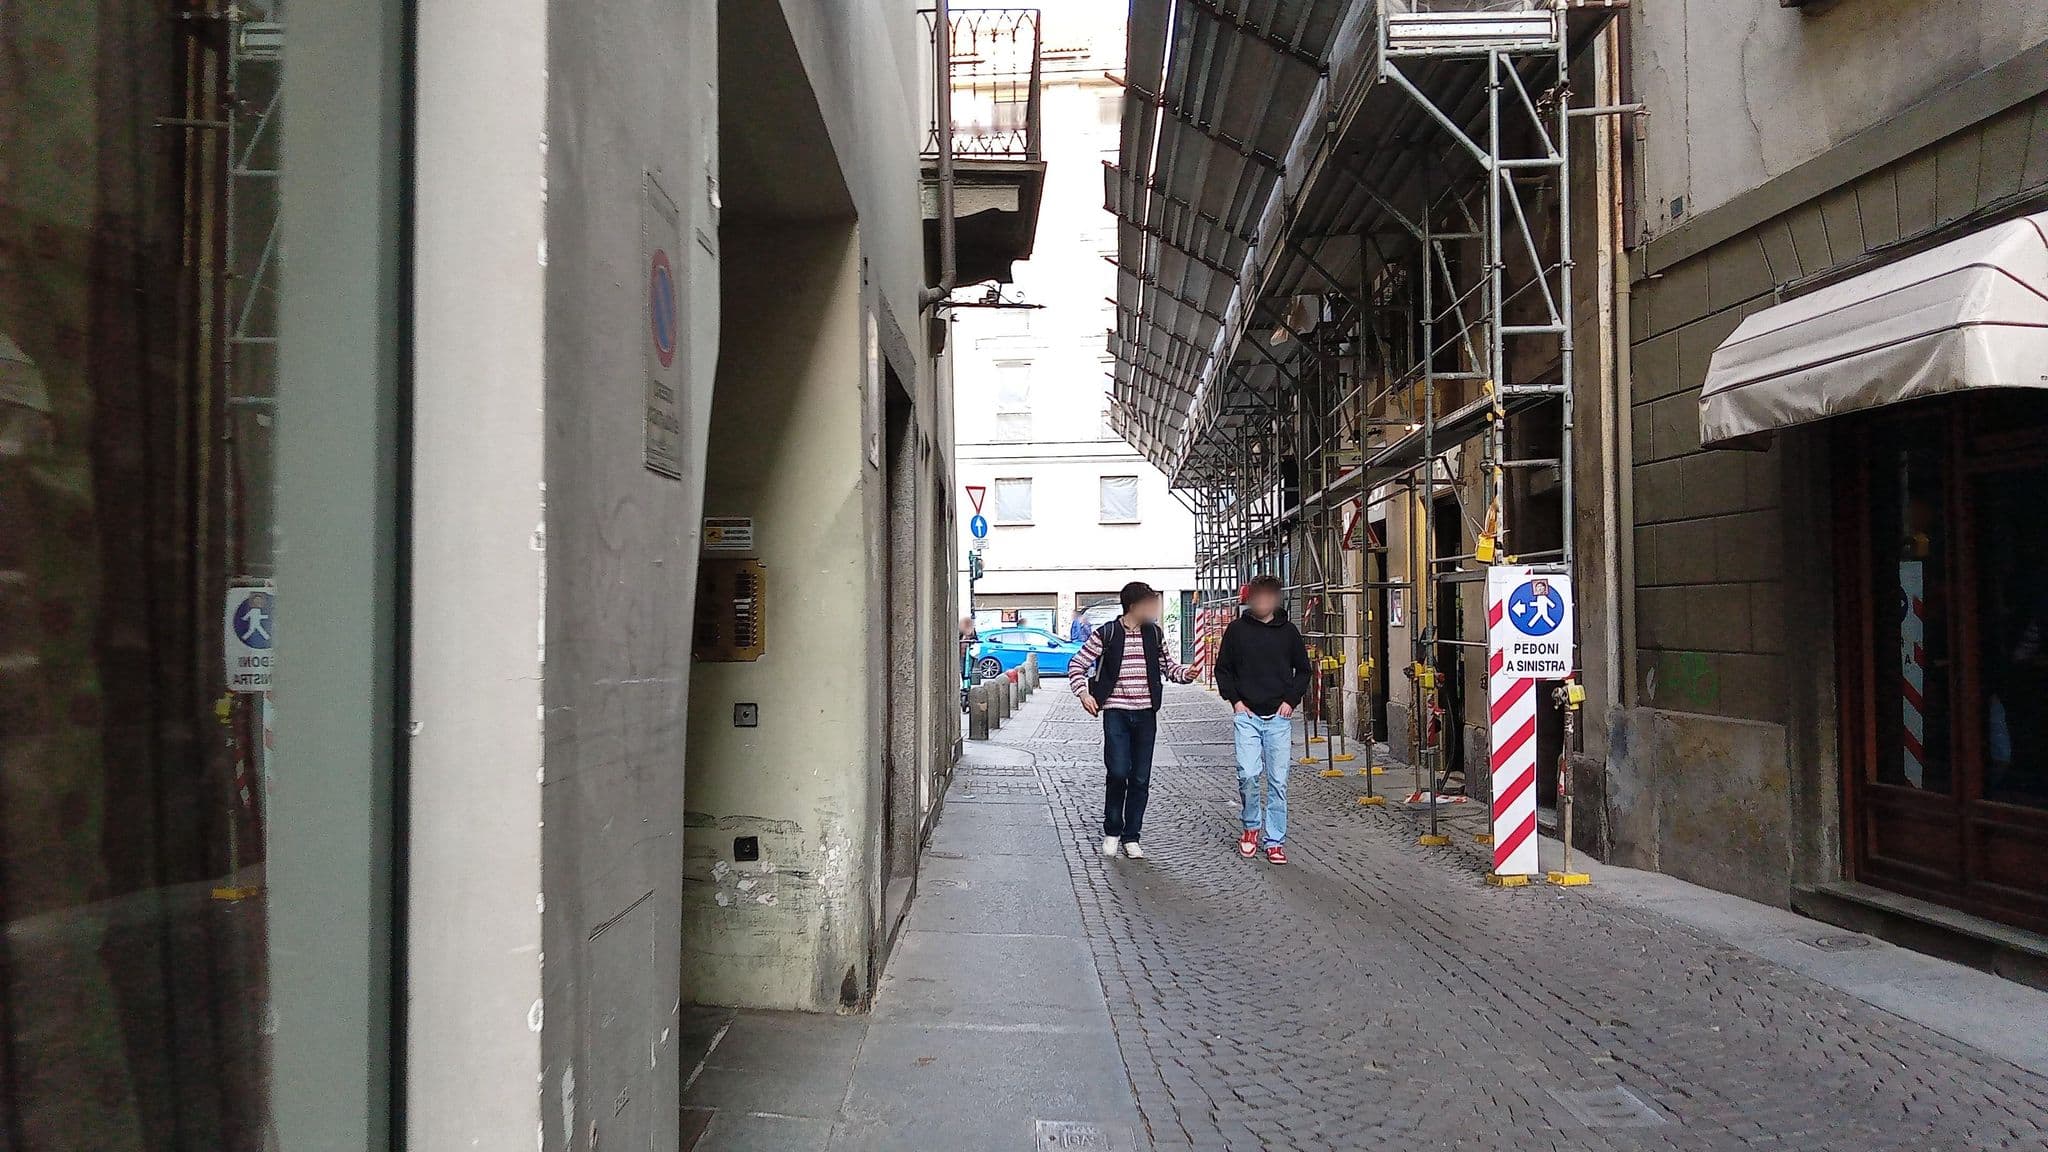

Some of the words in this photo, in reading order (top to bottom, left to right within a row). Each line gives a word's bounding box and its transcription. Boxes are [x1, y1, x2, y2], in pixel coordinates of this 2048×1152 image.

[1514, 643, 1559, 655] PEDONI
[1506, 661, 1514, 672] A
[1516, 660, 1566, 672] SINISTRA
